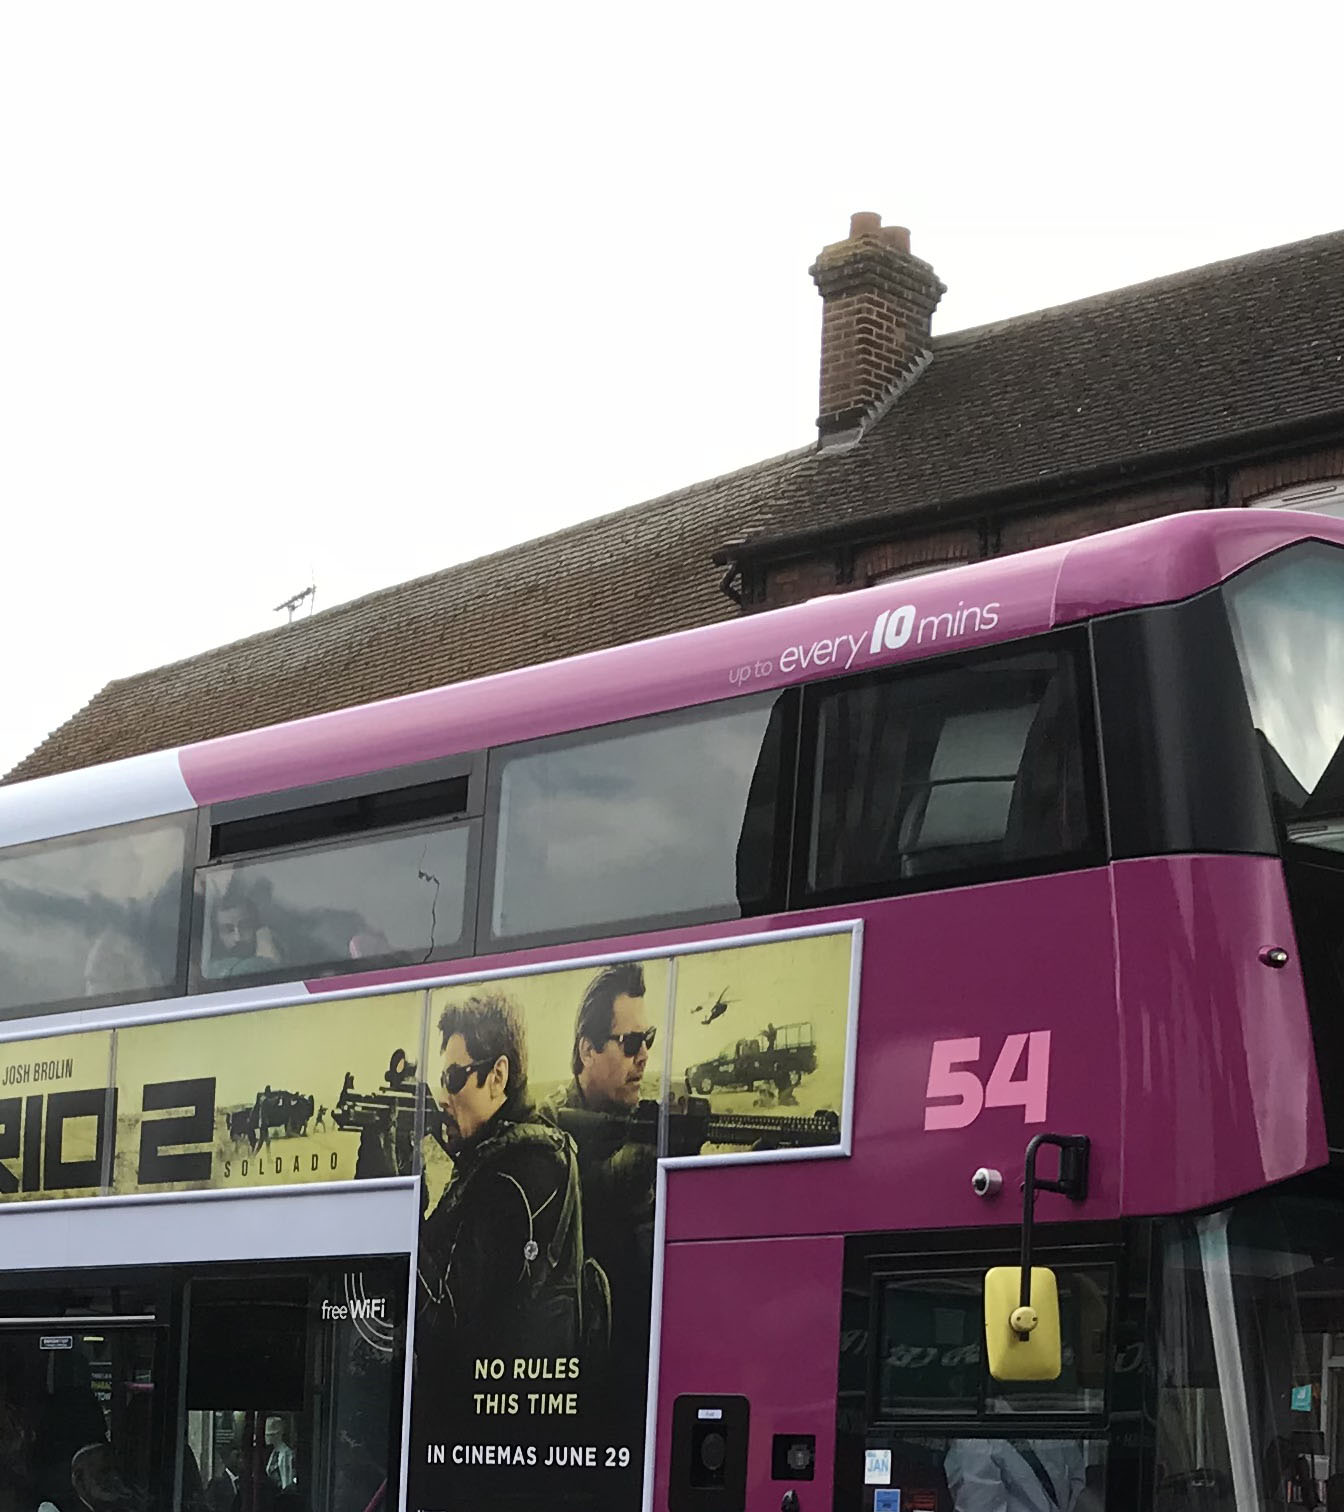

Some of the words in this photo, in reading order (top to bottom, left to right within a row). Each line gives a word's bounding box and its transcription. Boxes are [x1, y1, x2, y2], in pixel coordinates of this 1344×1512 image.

[728, 664, 751, 687] up
[754, 659, 773, 678] to
[779, 630, 868, 671] every
[870, 604, 917, 654] 10
[917, 601, 1000, 644] mins
[2, 1064, 30, 1086] JOSH
[33, 1058, 74, 1082] BROLIN
[924, 1030, 1052, 1131] 54
[137, 1077, 216, 1185] 2
[223, 1152, 338, 1178] SOLDADO
[321, 1300, 347, 1320] free
[350, 1298, 385, 1319] WiFi
[475, 1359, 504, 1380] NO
[513, 1357, 580, 1379] RULES
[473, 1393, 519, 1415] THIS
[528, 1393, 578, 1415] TIME
[427, 1445, 445, 1464] IN
[452, 1445, 537, 1466] CINEMAS
[544, 1446, 597, 1467] JUNE
[605, 1447, 630, 1468] 29
[867, 1459, 889, 1473] JAN
